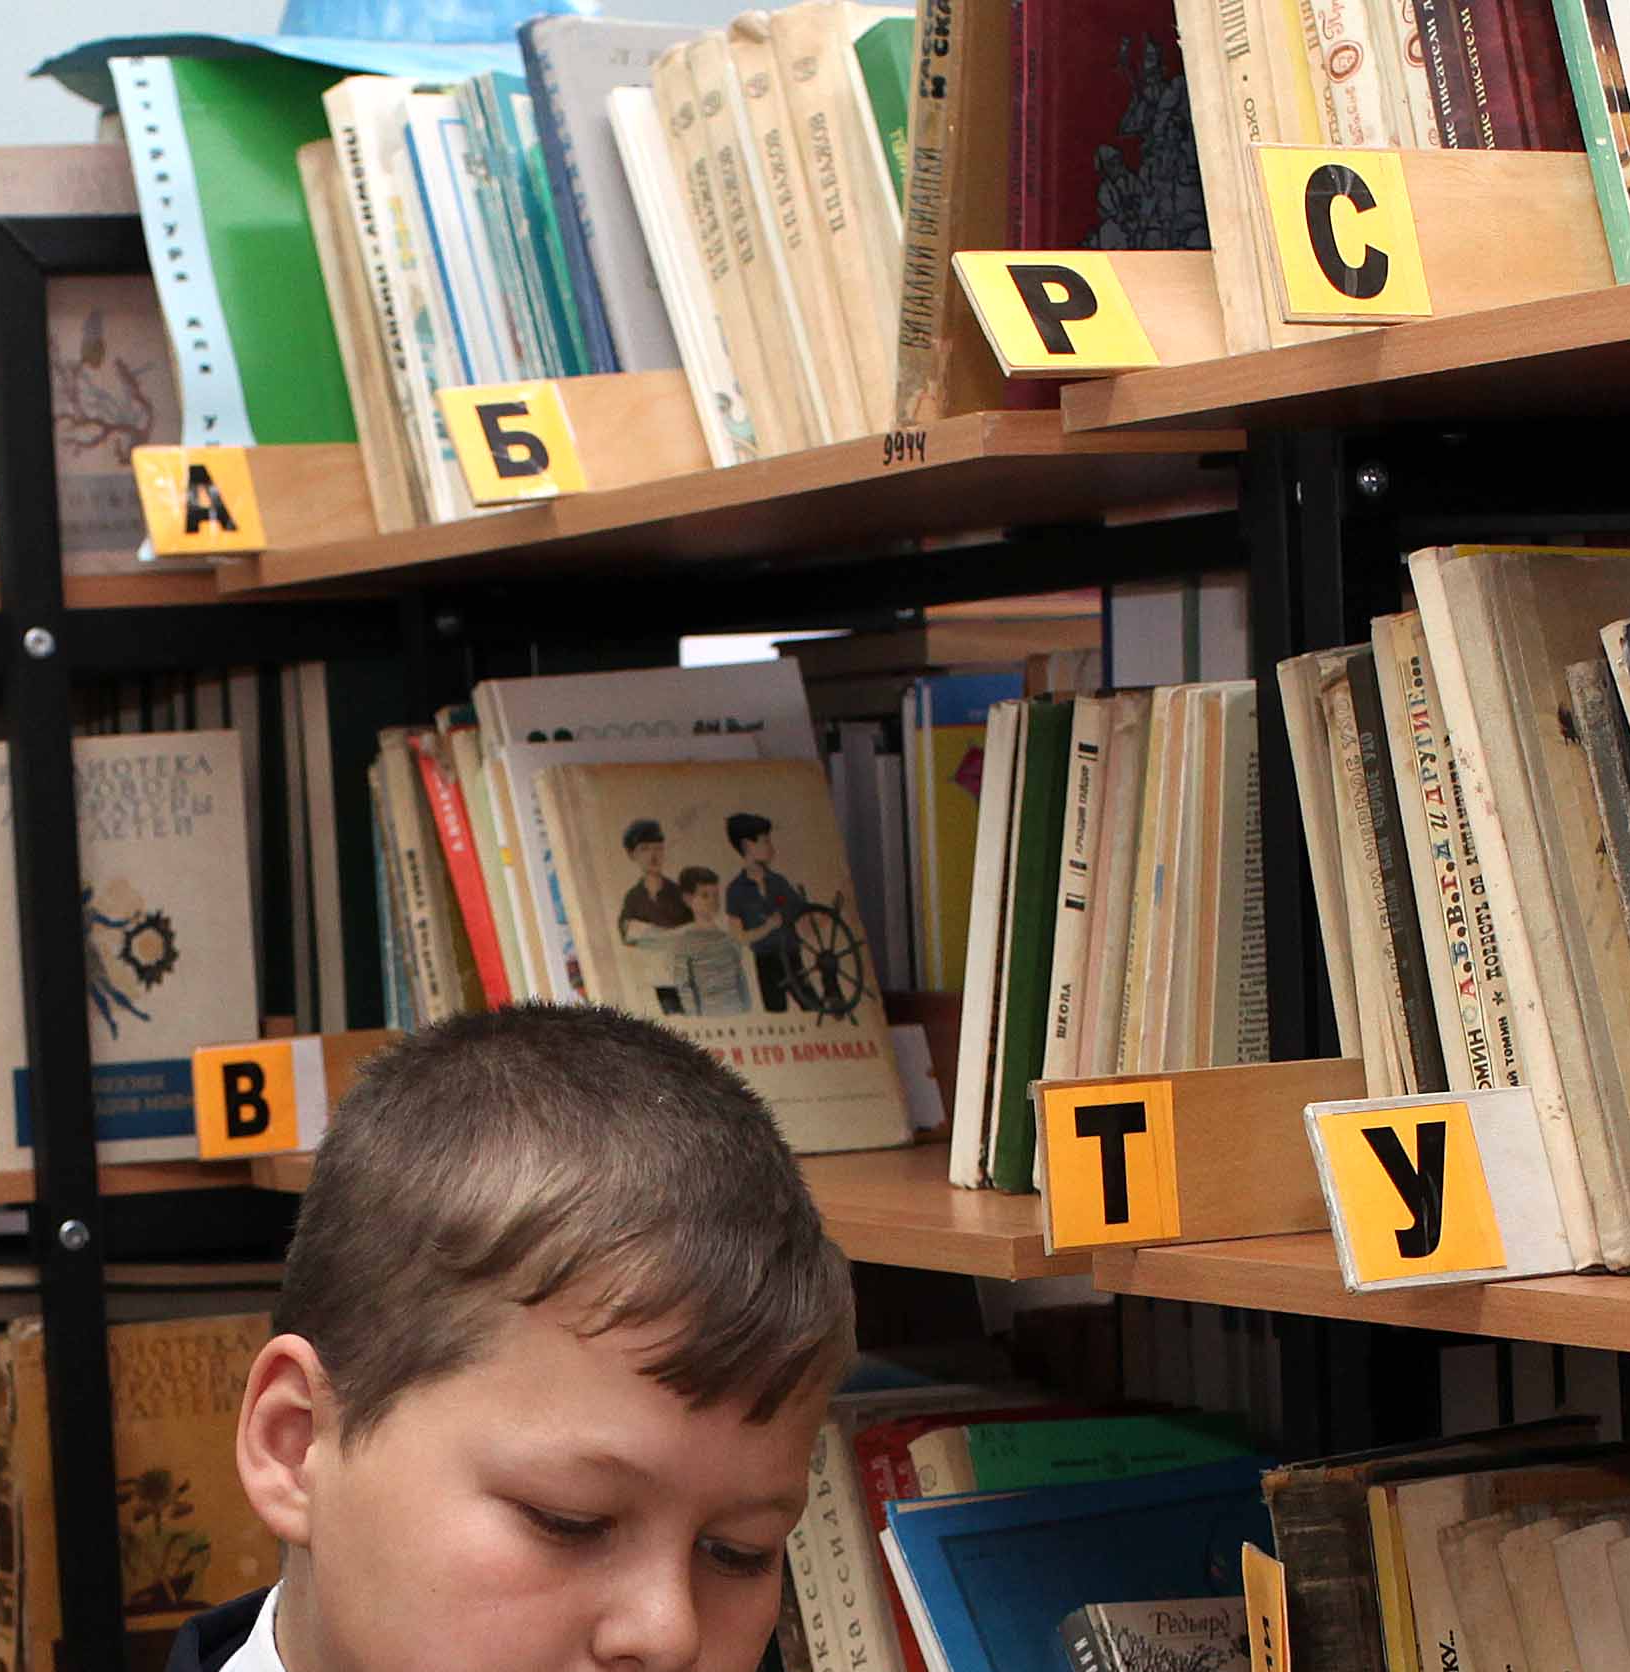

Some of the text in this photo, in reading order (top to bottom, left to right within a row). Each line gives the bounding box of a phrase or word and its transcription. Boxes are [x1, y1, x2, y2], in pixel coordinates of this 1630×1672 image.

[1304, 164, 1391, 300] С
[1006, 264, 1098, 355] Р
[474, 401, 551, 479] Б
[183, 464, 238, 534] А
[1055, 982, 1073, 1040] ШКОЛА
[1495, 1015, 1516, 1066] ТОМИН
[221, 1060, 270, 1140] В
[1073, 1102, 1147, 1226] Т
[1361, 1120, 1447, 1260] У
